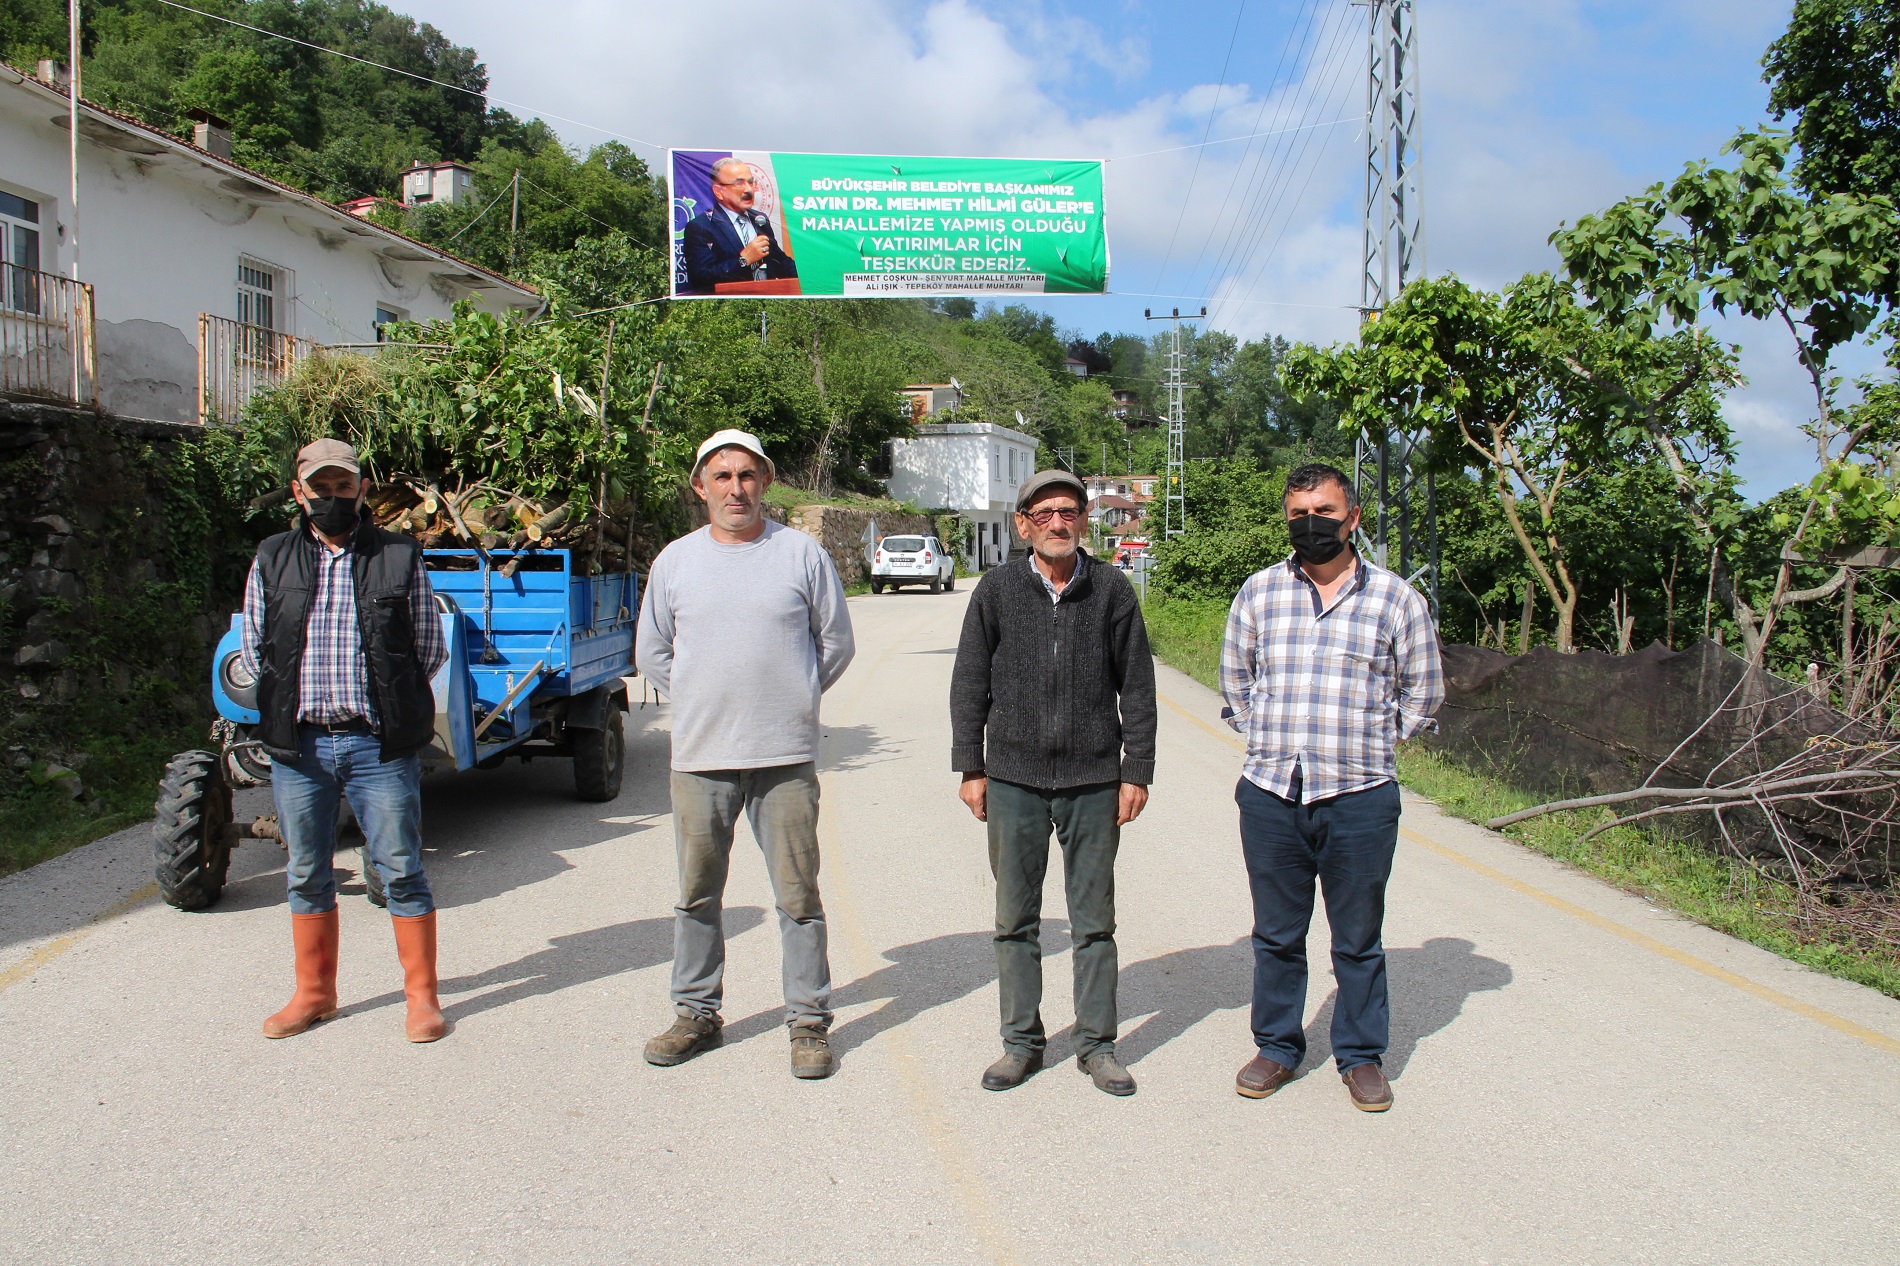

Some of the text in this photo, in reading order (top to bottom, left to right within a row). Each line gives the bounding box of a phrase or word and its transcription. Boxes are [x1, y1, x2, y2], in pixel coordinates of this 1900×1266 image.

[811, 177, 1075, 196] BÜYÜKŞEHİR BELEDİYE BAŞKANIMIZ
[792, 195, 1095, 214] SAYIN DR. MEHMET HİLMİ GÜLER'E
[802, 215, 1086, 235] MAHALLEMİZE YAPMIŞ OLDUĞU
[871, 234, 1022, 254] YATIRIMLAR İÇİN
[861, 254, 1031, 273] TEŞEKKÜR EDERİZ.
[881, 283, 898, 291] IŞIK
[906, 282, 942, 290] TEPEKÖY
[883, 274, 918, 283] COŞKUN
[925, 274, 964, 283] ŞENYURT
